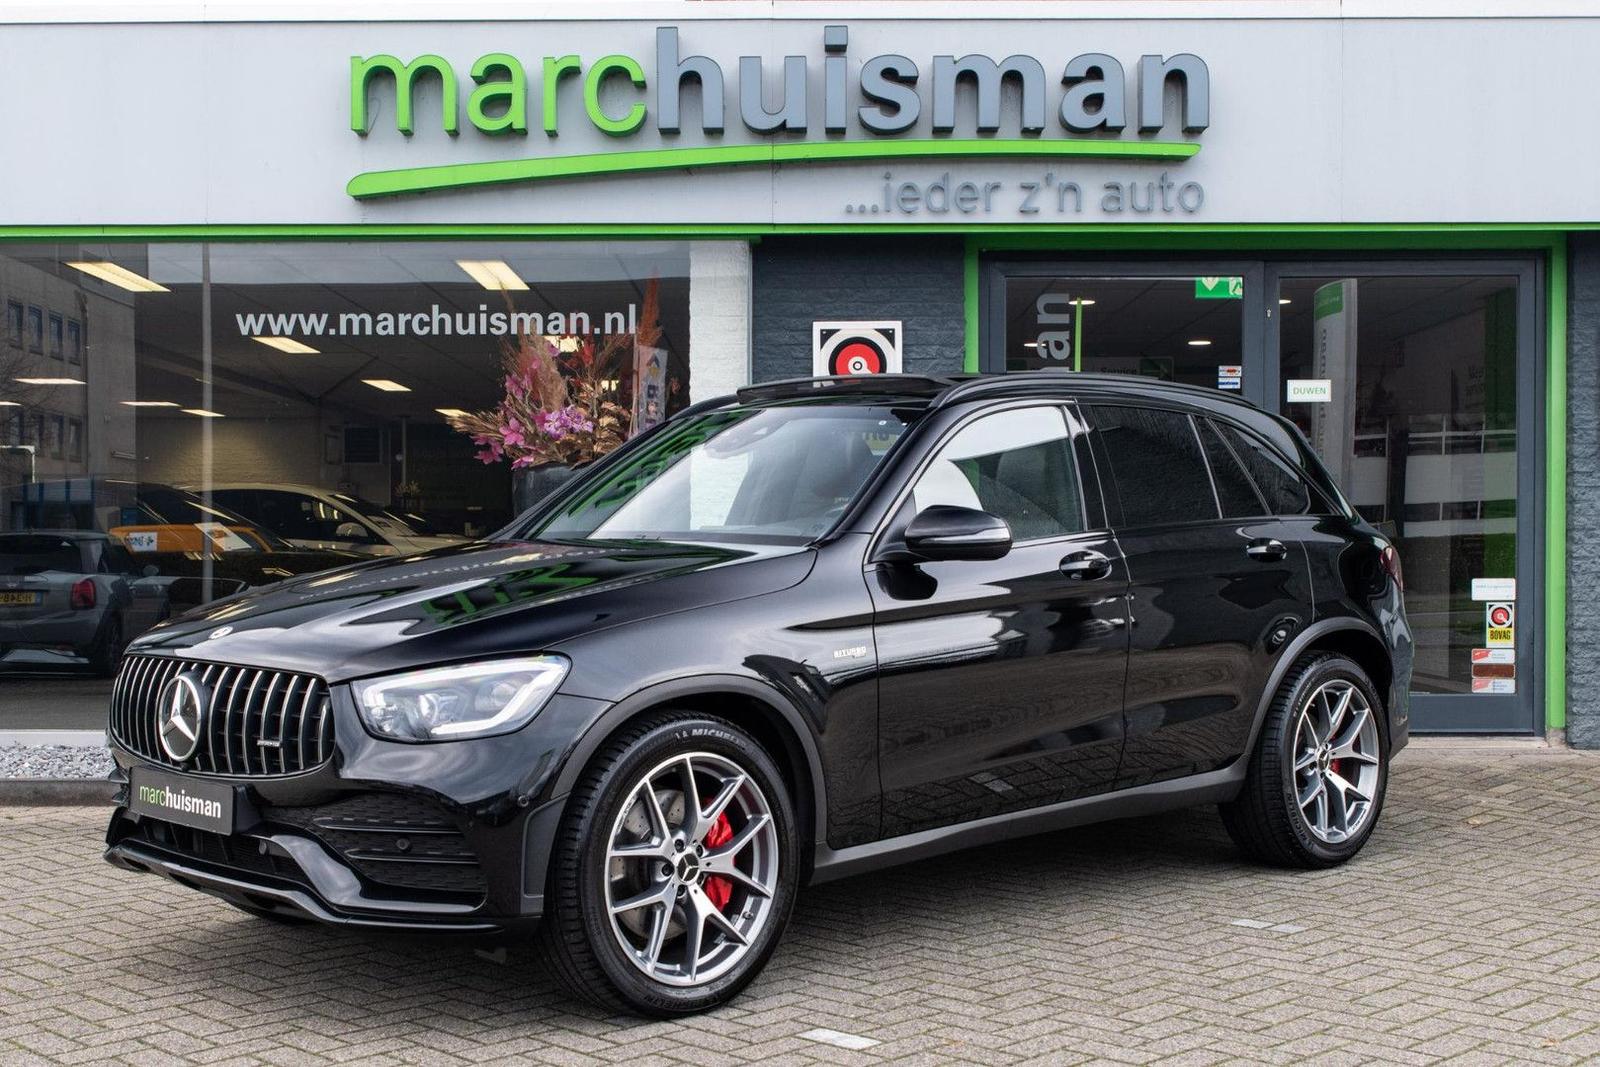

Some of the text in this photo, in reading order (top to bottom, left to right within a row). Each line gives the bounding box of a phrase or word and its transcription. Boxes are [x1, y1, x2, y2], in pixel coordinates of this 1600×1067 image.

[350, 25, 1210, 136] marchuisman
[845, 171, 1205, 214] ...ieder z'n auto
[235, 303, 637, 336] www.marchuisman.nl
[1036, 292, 1071, 373] an
[1293, 386, 1326, 395] DUWEN
[1489, 629, 1511, 641] BOVAG
[139, 785, 221, 818] marchuisman
